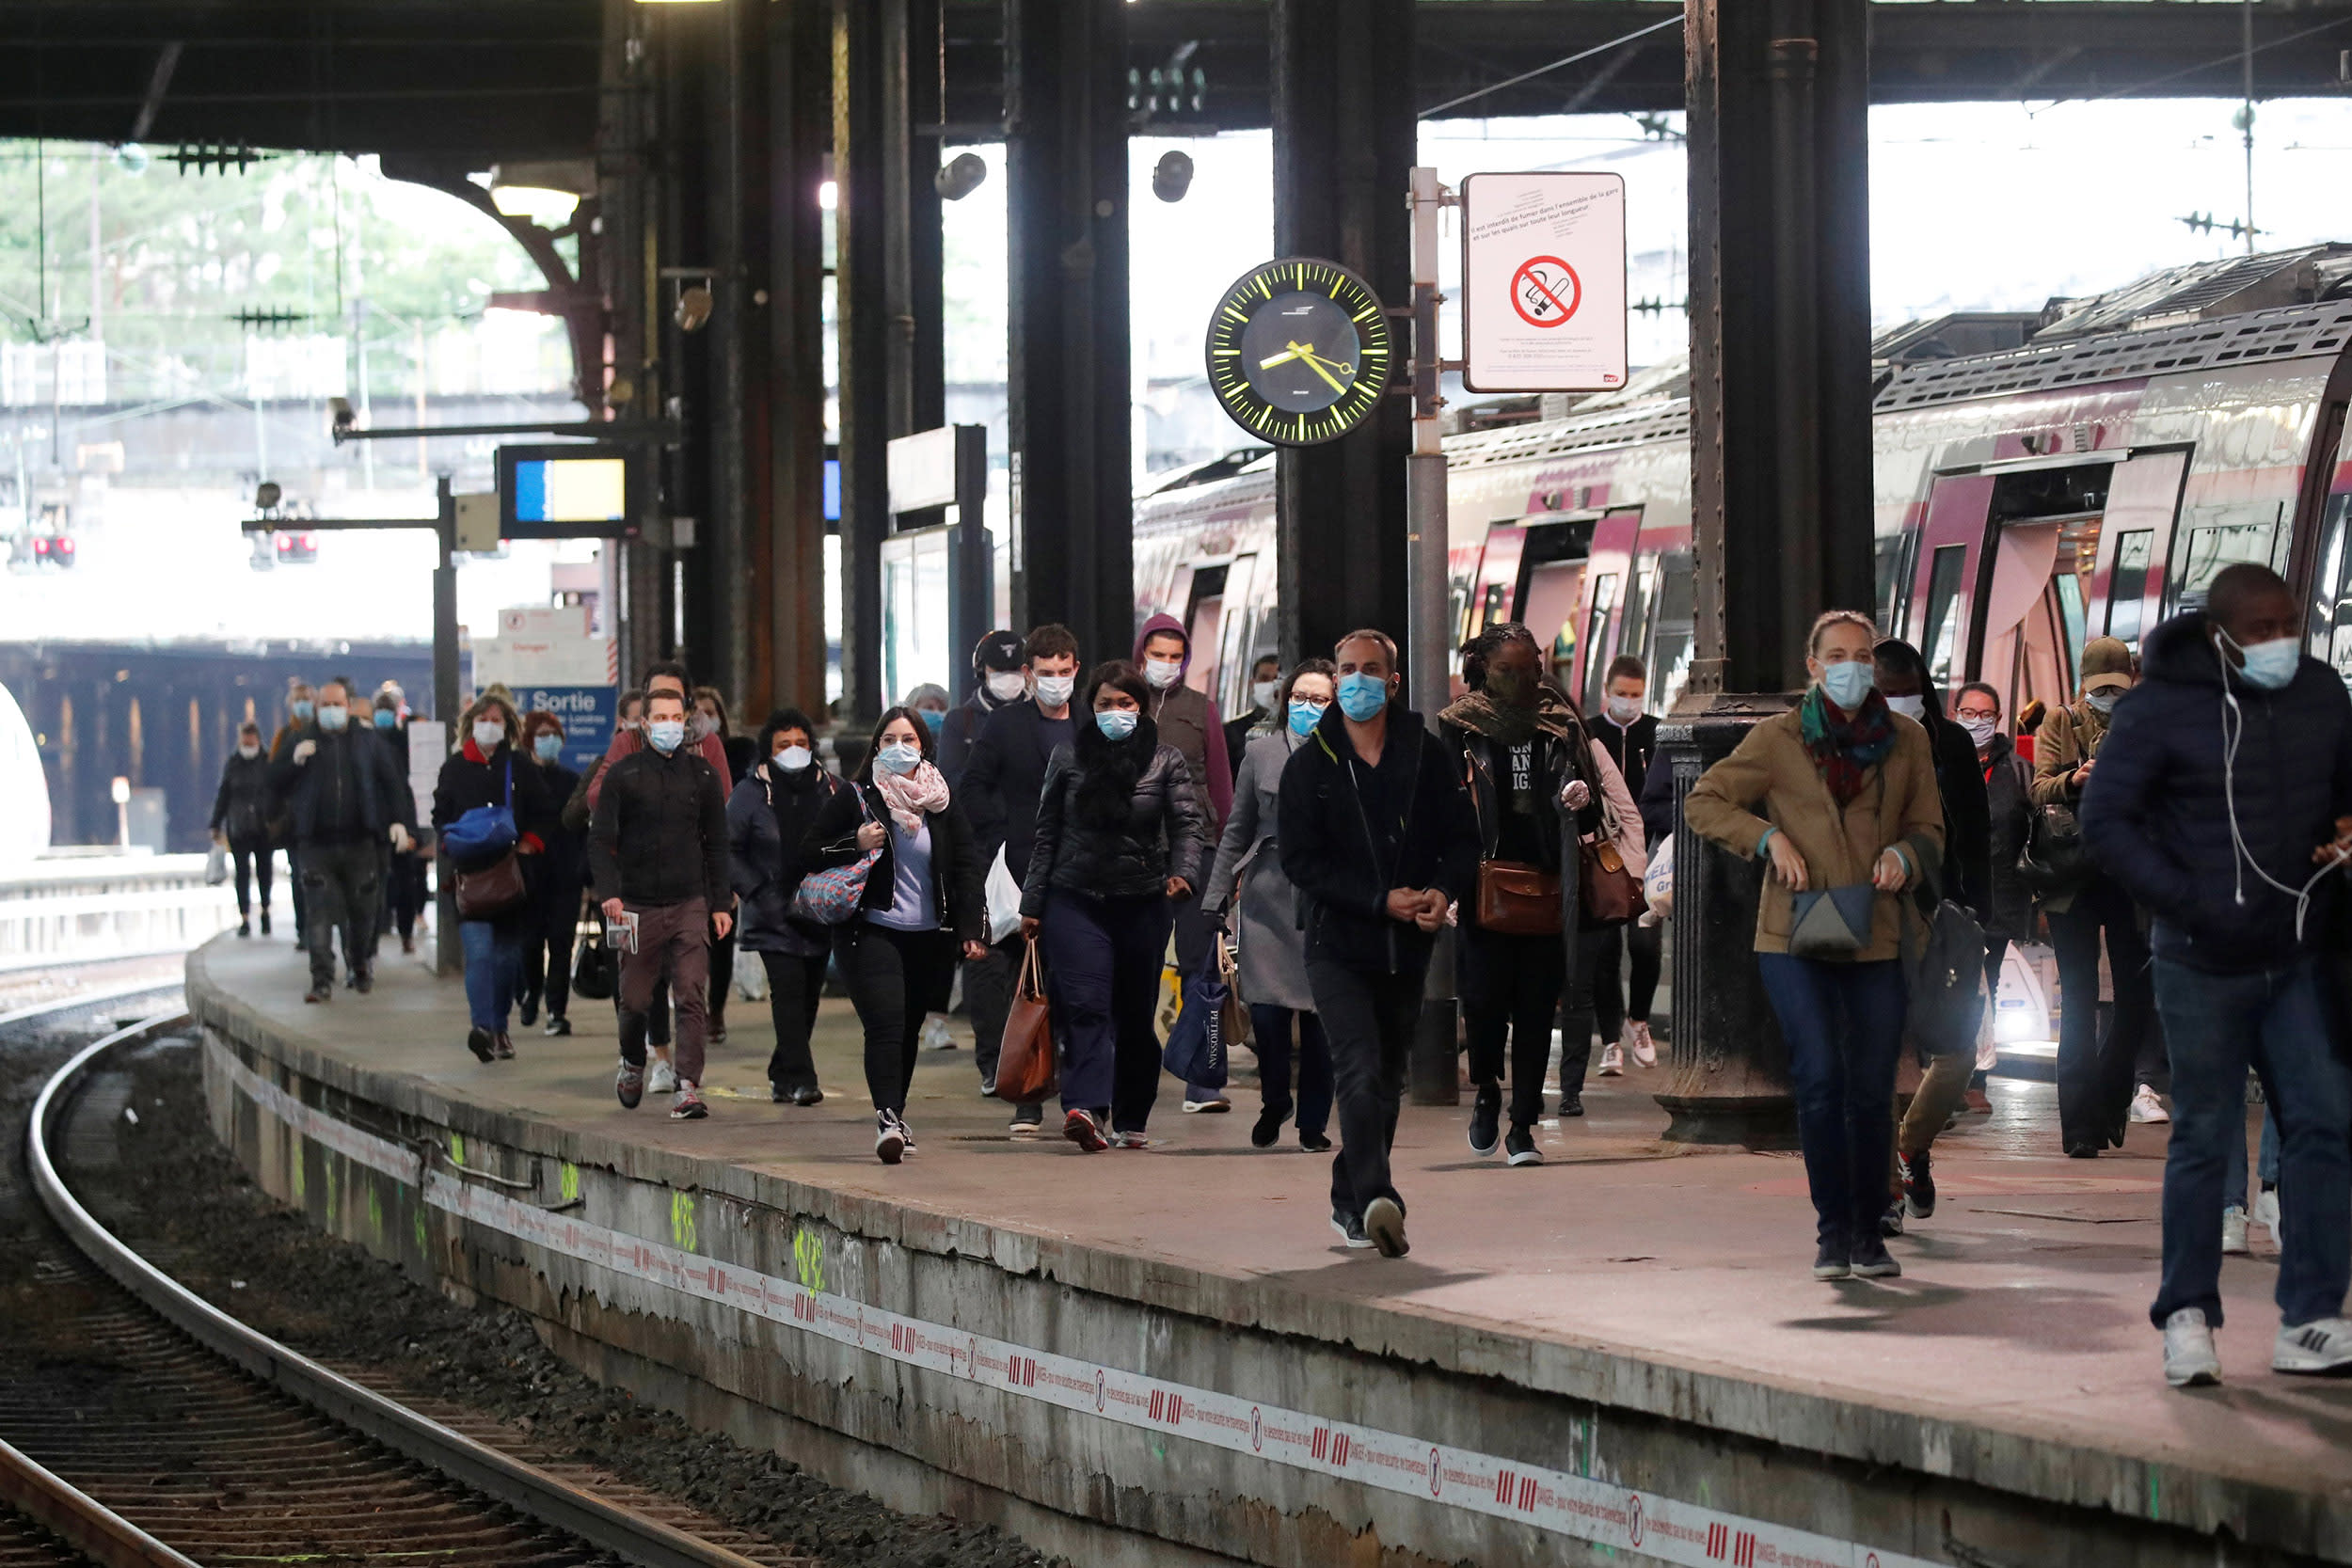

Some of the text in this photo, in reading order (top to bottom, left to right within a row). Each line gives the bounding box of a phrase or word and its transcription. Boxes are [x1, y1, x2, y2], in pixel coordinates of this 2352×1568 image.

[1487, 218, 1509, 230] interdit
[1520, 210, 1538, 220] fumer
[1540, 206, 1554, 214] dans
[1606, 188, 1619, 197] gare
[1502, 224, 1518, 233] quais
[1530, 216, 1547, 226] toute
[1562, 205, 1589, 216] longueur
[532, 690, 596, 712] Sortie
[1513, 772, 1532, 790] IG
[1657, 880, 1673, 893] Gr
[1209, 1010, 1218, 1069] PETROSSIAN
